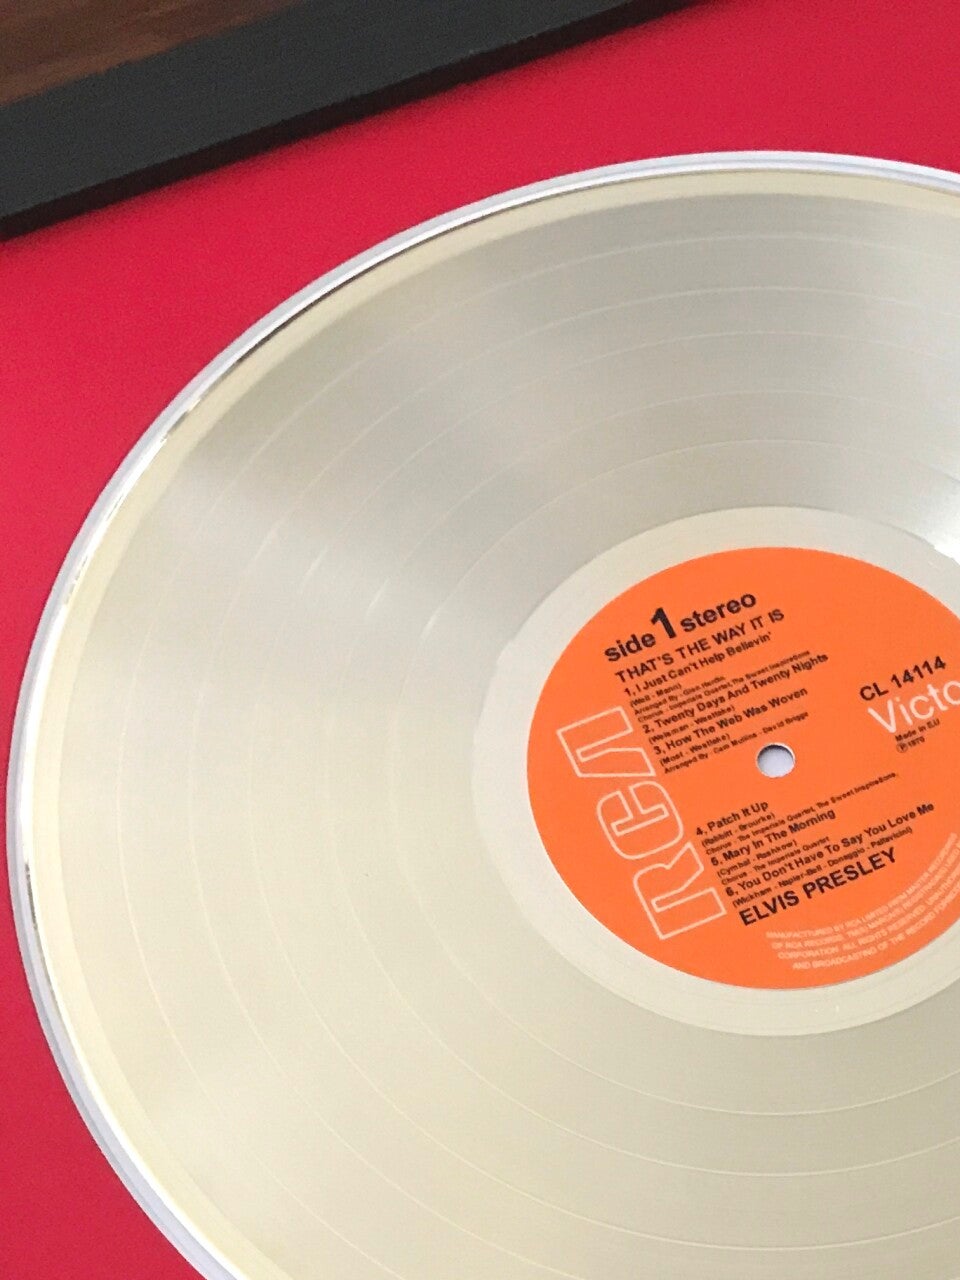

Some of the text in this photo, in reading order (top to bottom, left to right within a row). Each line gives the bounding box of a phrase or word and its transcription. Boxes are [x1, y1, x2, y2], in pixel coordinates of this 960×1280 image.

[604, 593, 756, 662] side 1 stereo
[614, 609, 784, 683] THAT'S THE WAY IT IS
[643, 675, 668, 690] Just
[668, 662, 699, 679] Can't
[698, 653, 725, 667] Help
[725, 631, 771, 657] Believin'
[654, 708, 694, 728] Twenty
[696, 696, 725, 712] Days
[728, 684, 750, 700] And
[750, 669, 790, 689] Twenty
[791, 654, 828, 673] Nights
[859, 656, 946, 701] CL 14114
[665, 735, 692, 750] How
[693, 726, 715, 738] The
[716, 714, 743, 729] Web
[742, 704, 768, 718] Was
[768, 688, 808, 708] Woven
[556, 704, 727, 940] RCA
[707, 813, 741, 831] Patch
[741, 808, 751, 817] It
[750, 802, 768, 813] Up
[722, 845, 750, 861] Mary
[752, 840, 764, 849] In
[764, 830, 787, 843] The
[788, 809, 836, 834] Morning
[737, 878, 761, 890] You
[762, 863, 794, 881] Don't
[794, 851, 824, 868] Have
[825, 844, 840, 854] To
[841, 834, 863, 847] Say
[864, 824, 887, 837] You
[887, 811, 916, 828] Love
[916, 804, 934, 815] Me
[739, 891, 799, 926] ELVIS
[802, 847, 895, 899] PRESLEY
